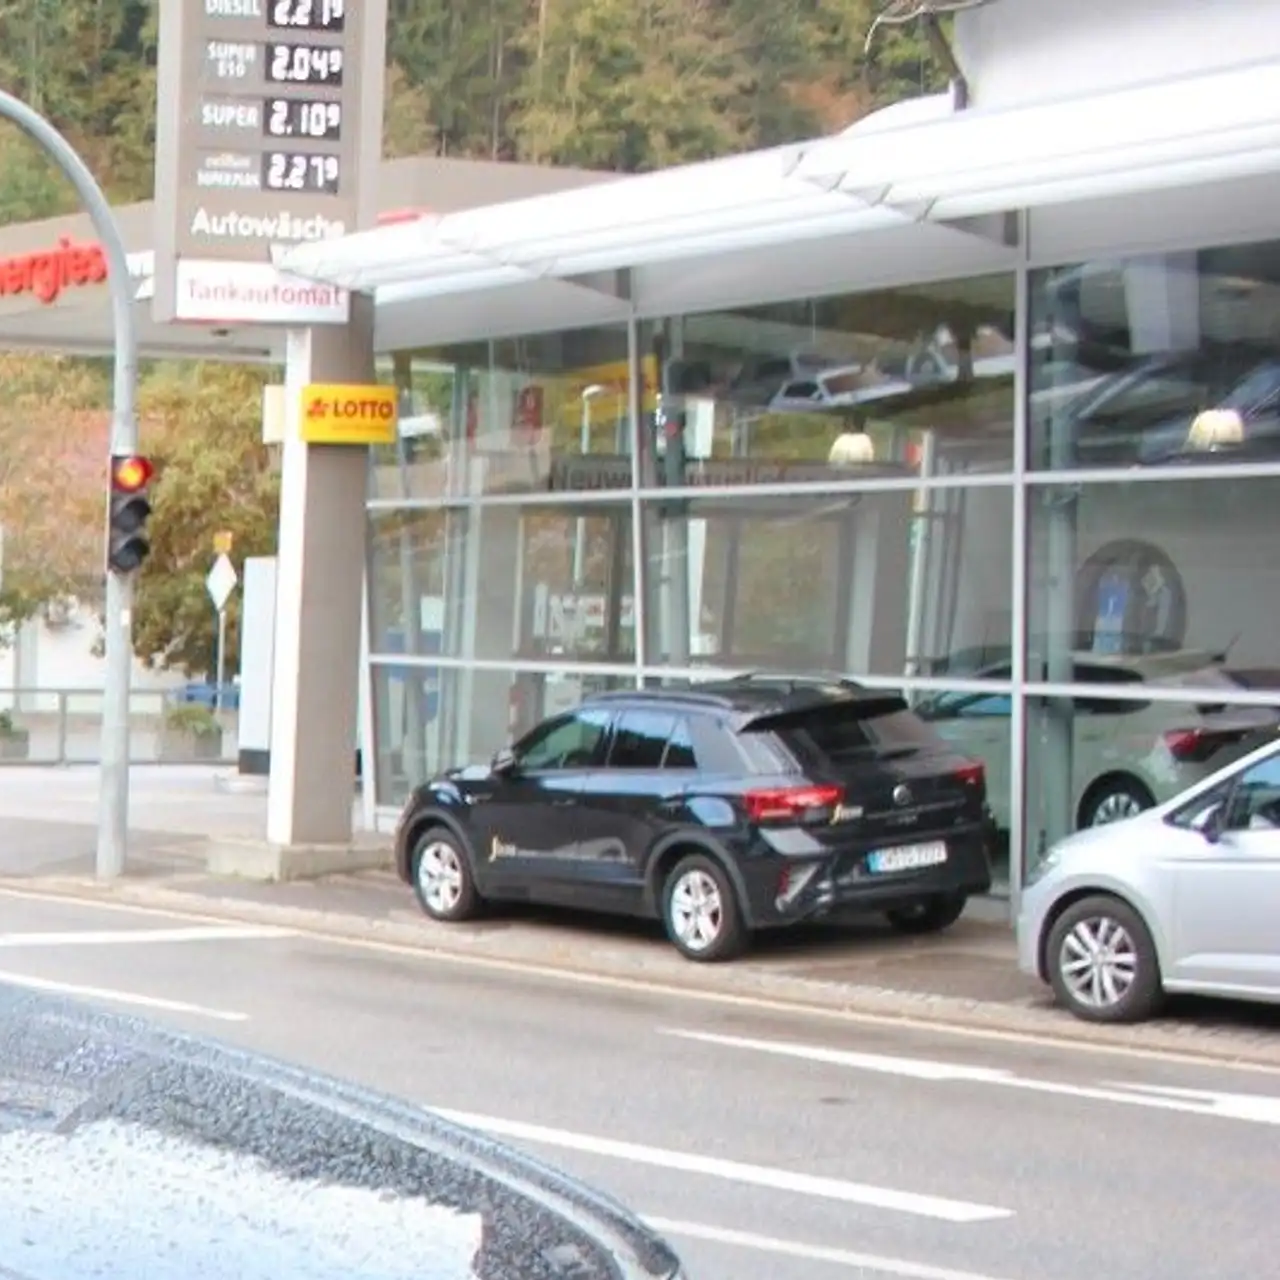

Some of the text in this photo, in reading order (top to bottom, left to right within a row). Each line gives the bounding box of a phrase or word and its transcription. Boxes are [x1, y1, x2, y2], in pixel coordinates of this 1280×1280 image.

[207, 40, 257, 63] SUPER
[202, 102, 258, 128] SUPER
[191, 207, 345, 241] Autowäsche
[332, 397, 395, 421] LOTTO
